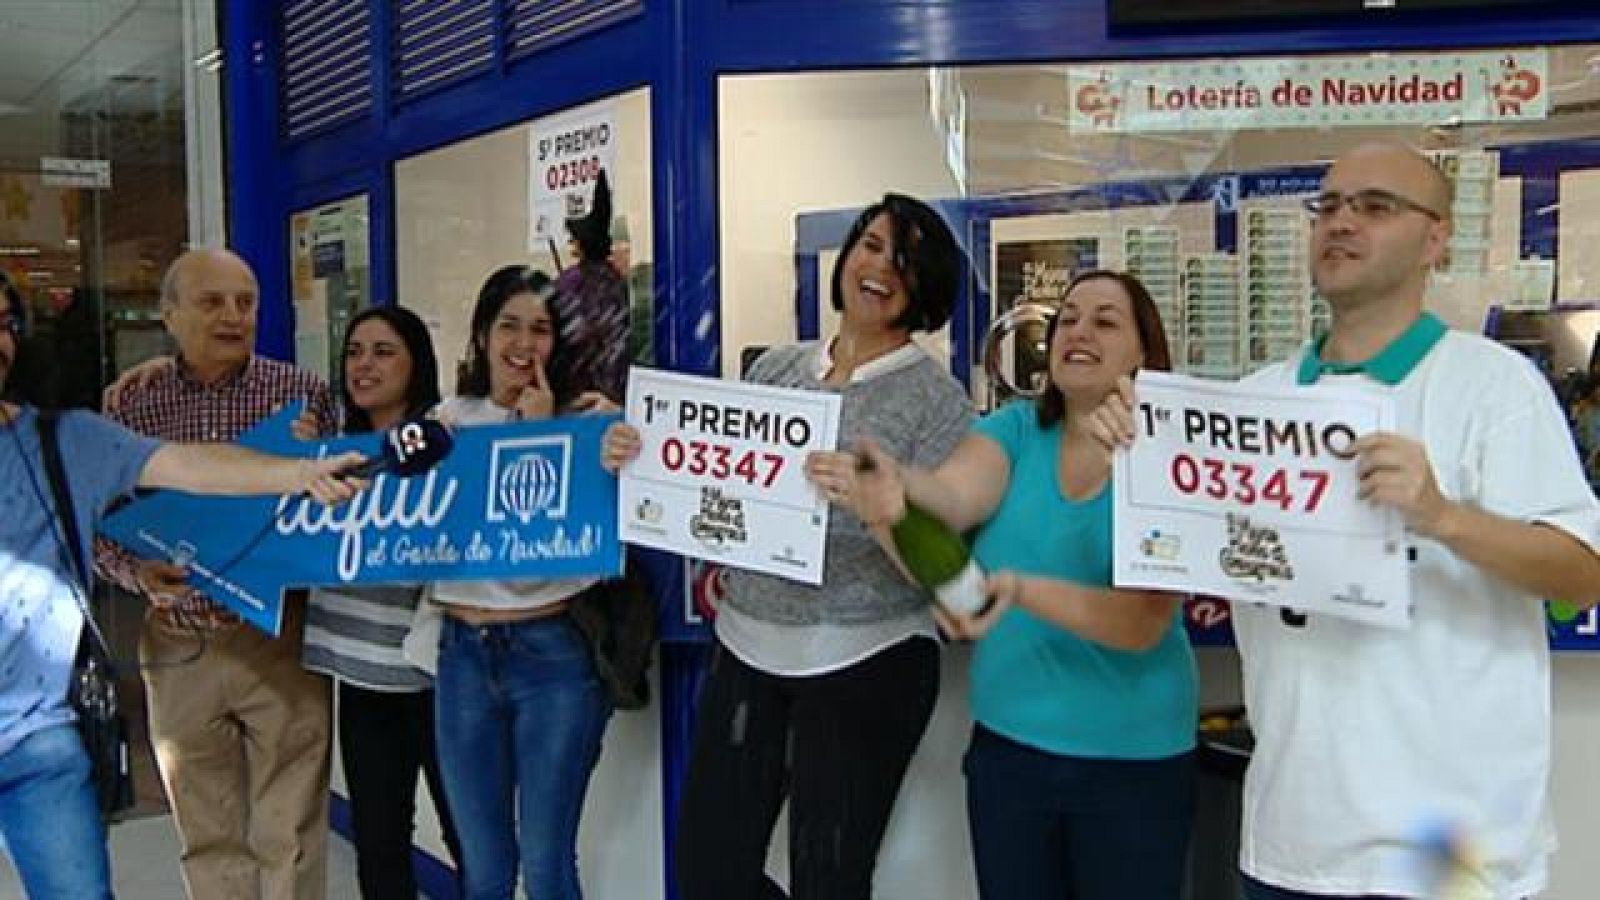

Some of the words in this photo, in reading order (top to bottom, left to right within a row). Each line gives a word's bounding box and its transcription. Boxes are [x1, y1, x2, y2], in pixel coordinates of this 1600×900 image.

[1147, 80, 1261, 111] Lotería
[1272, 79, 1313, 107] de
[1322, 73, 1463, 106] Navidad
[555, 123, 610, 157] PREMIO
[679, 400, 811, 448] PREMIO
[1184, 406, 1358, 460] PREMIO
[661, 437, 785, 489] 03347
[1171, 454, 1330, 513] 03347
